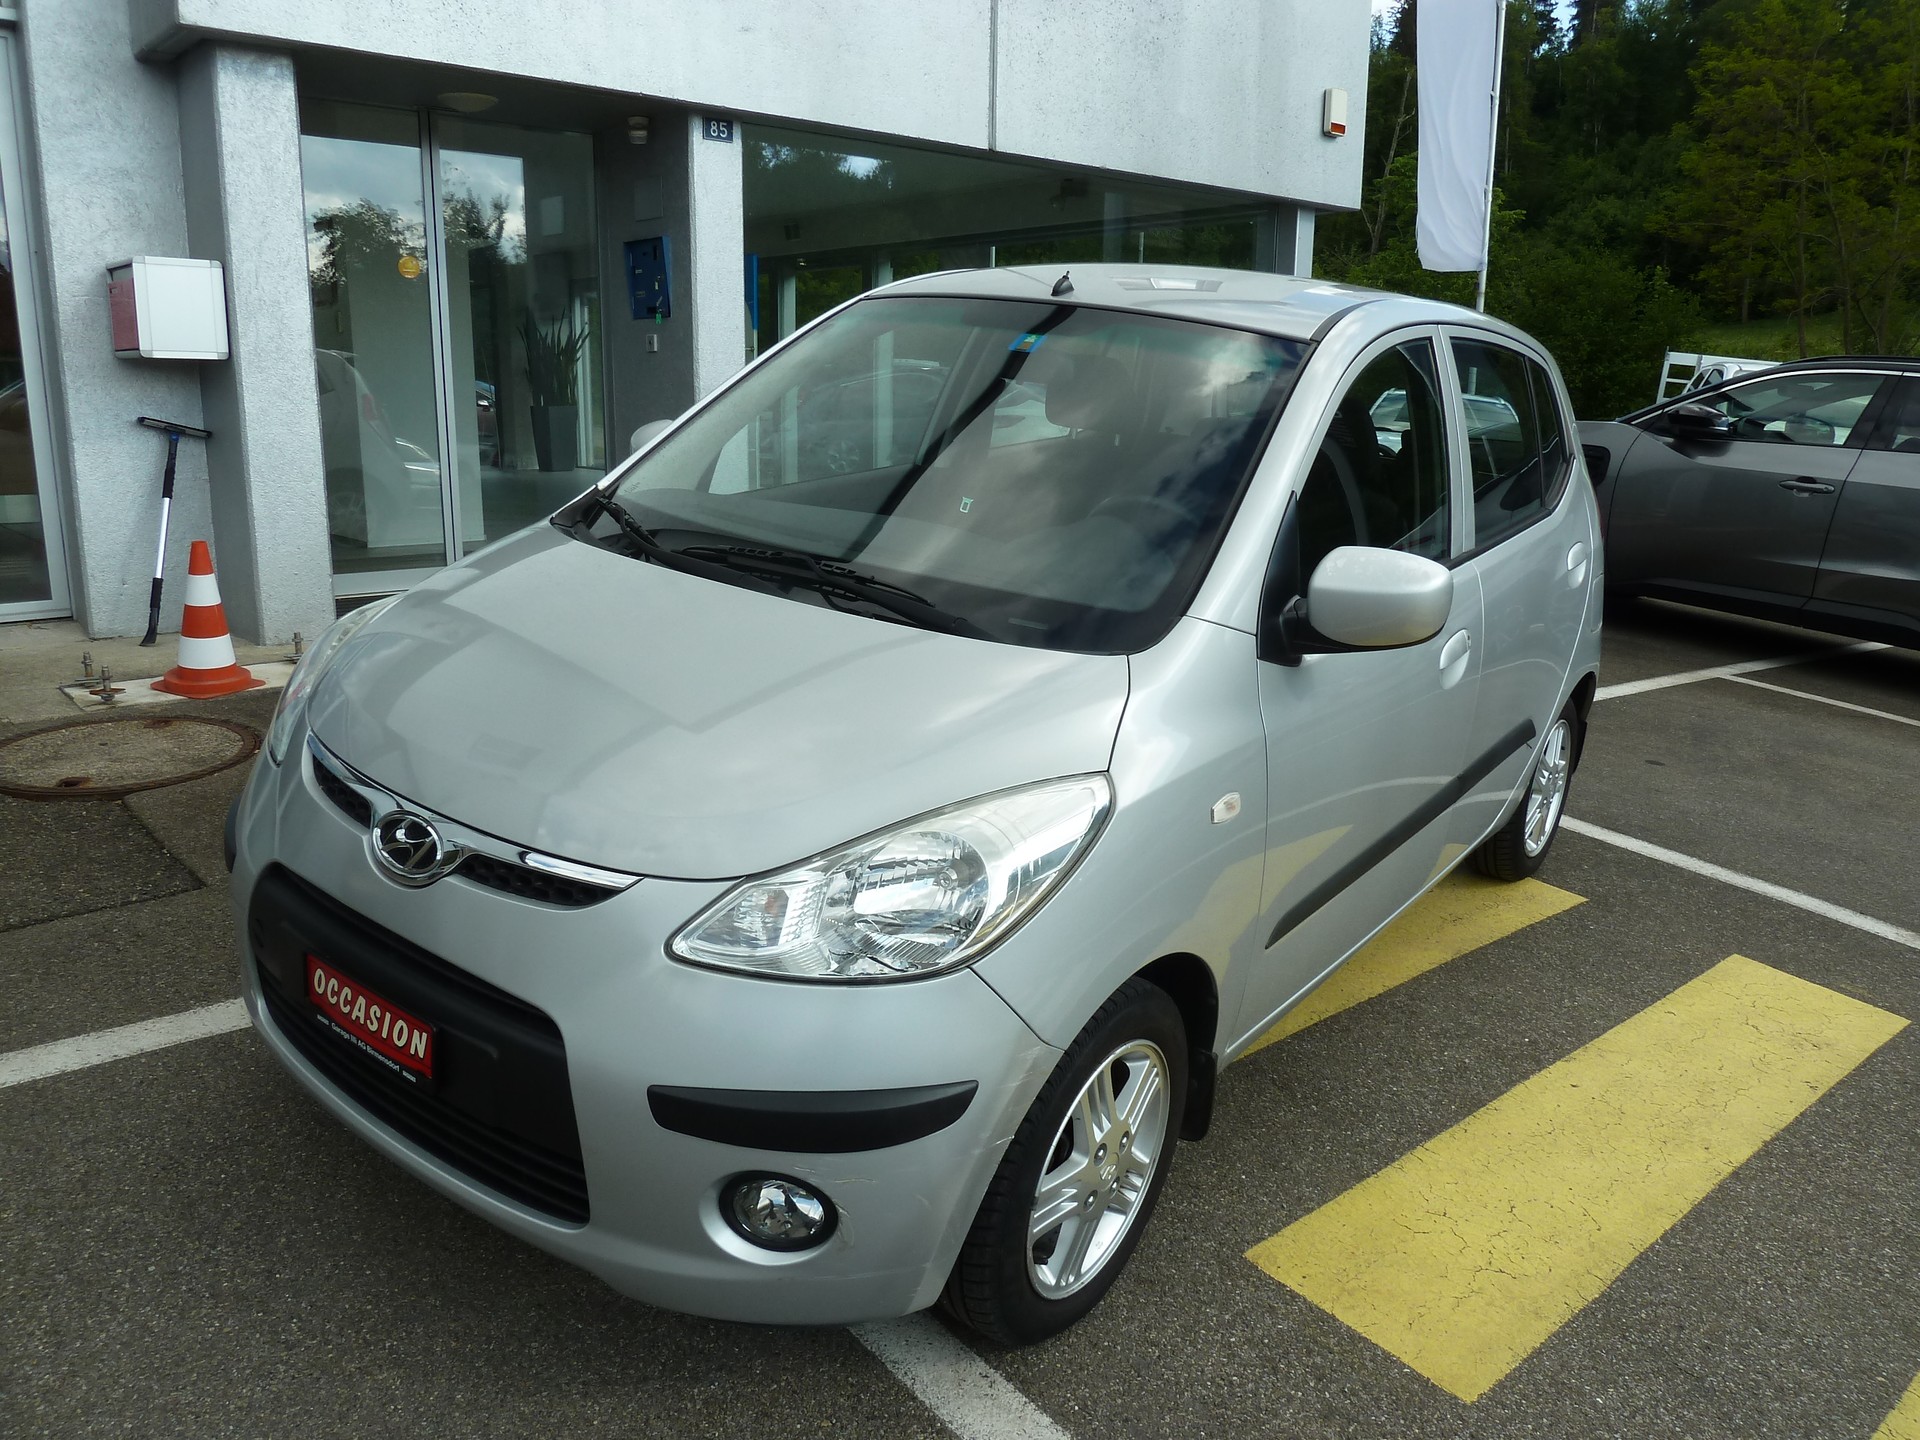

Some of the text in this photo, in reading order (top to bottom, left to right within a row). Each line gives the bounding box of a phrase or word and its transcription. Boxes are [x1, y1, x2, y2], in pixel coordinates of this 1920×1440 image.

[710, 120, 728, 138] 85
[313, 968, 428, 1059] OCCASION
[357, 1039, 367, 1050] AG
